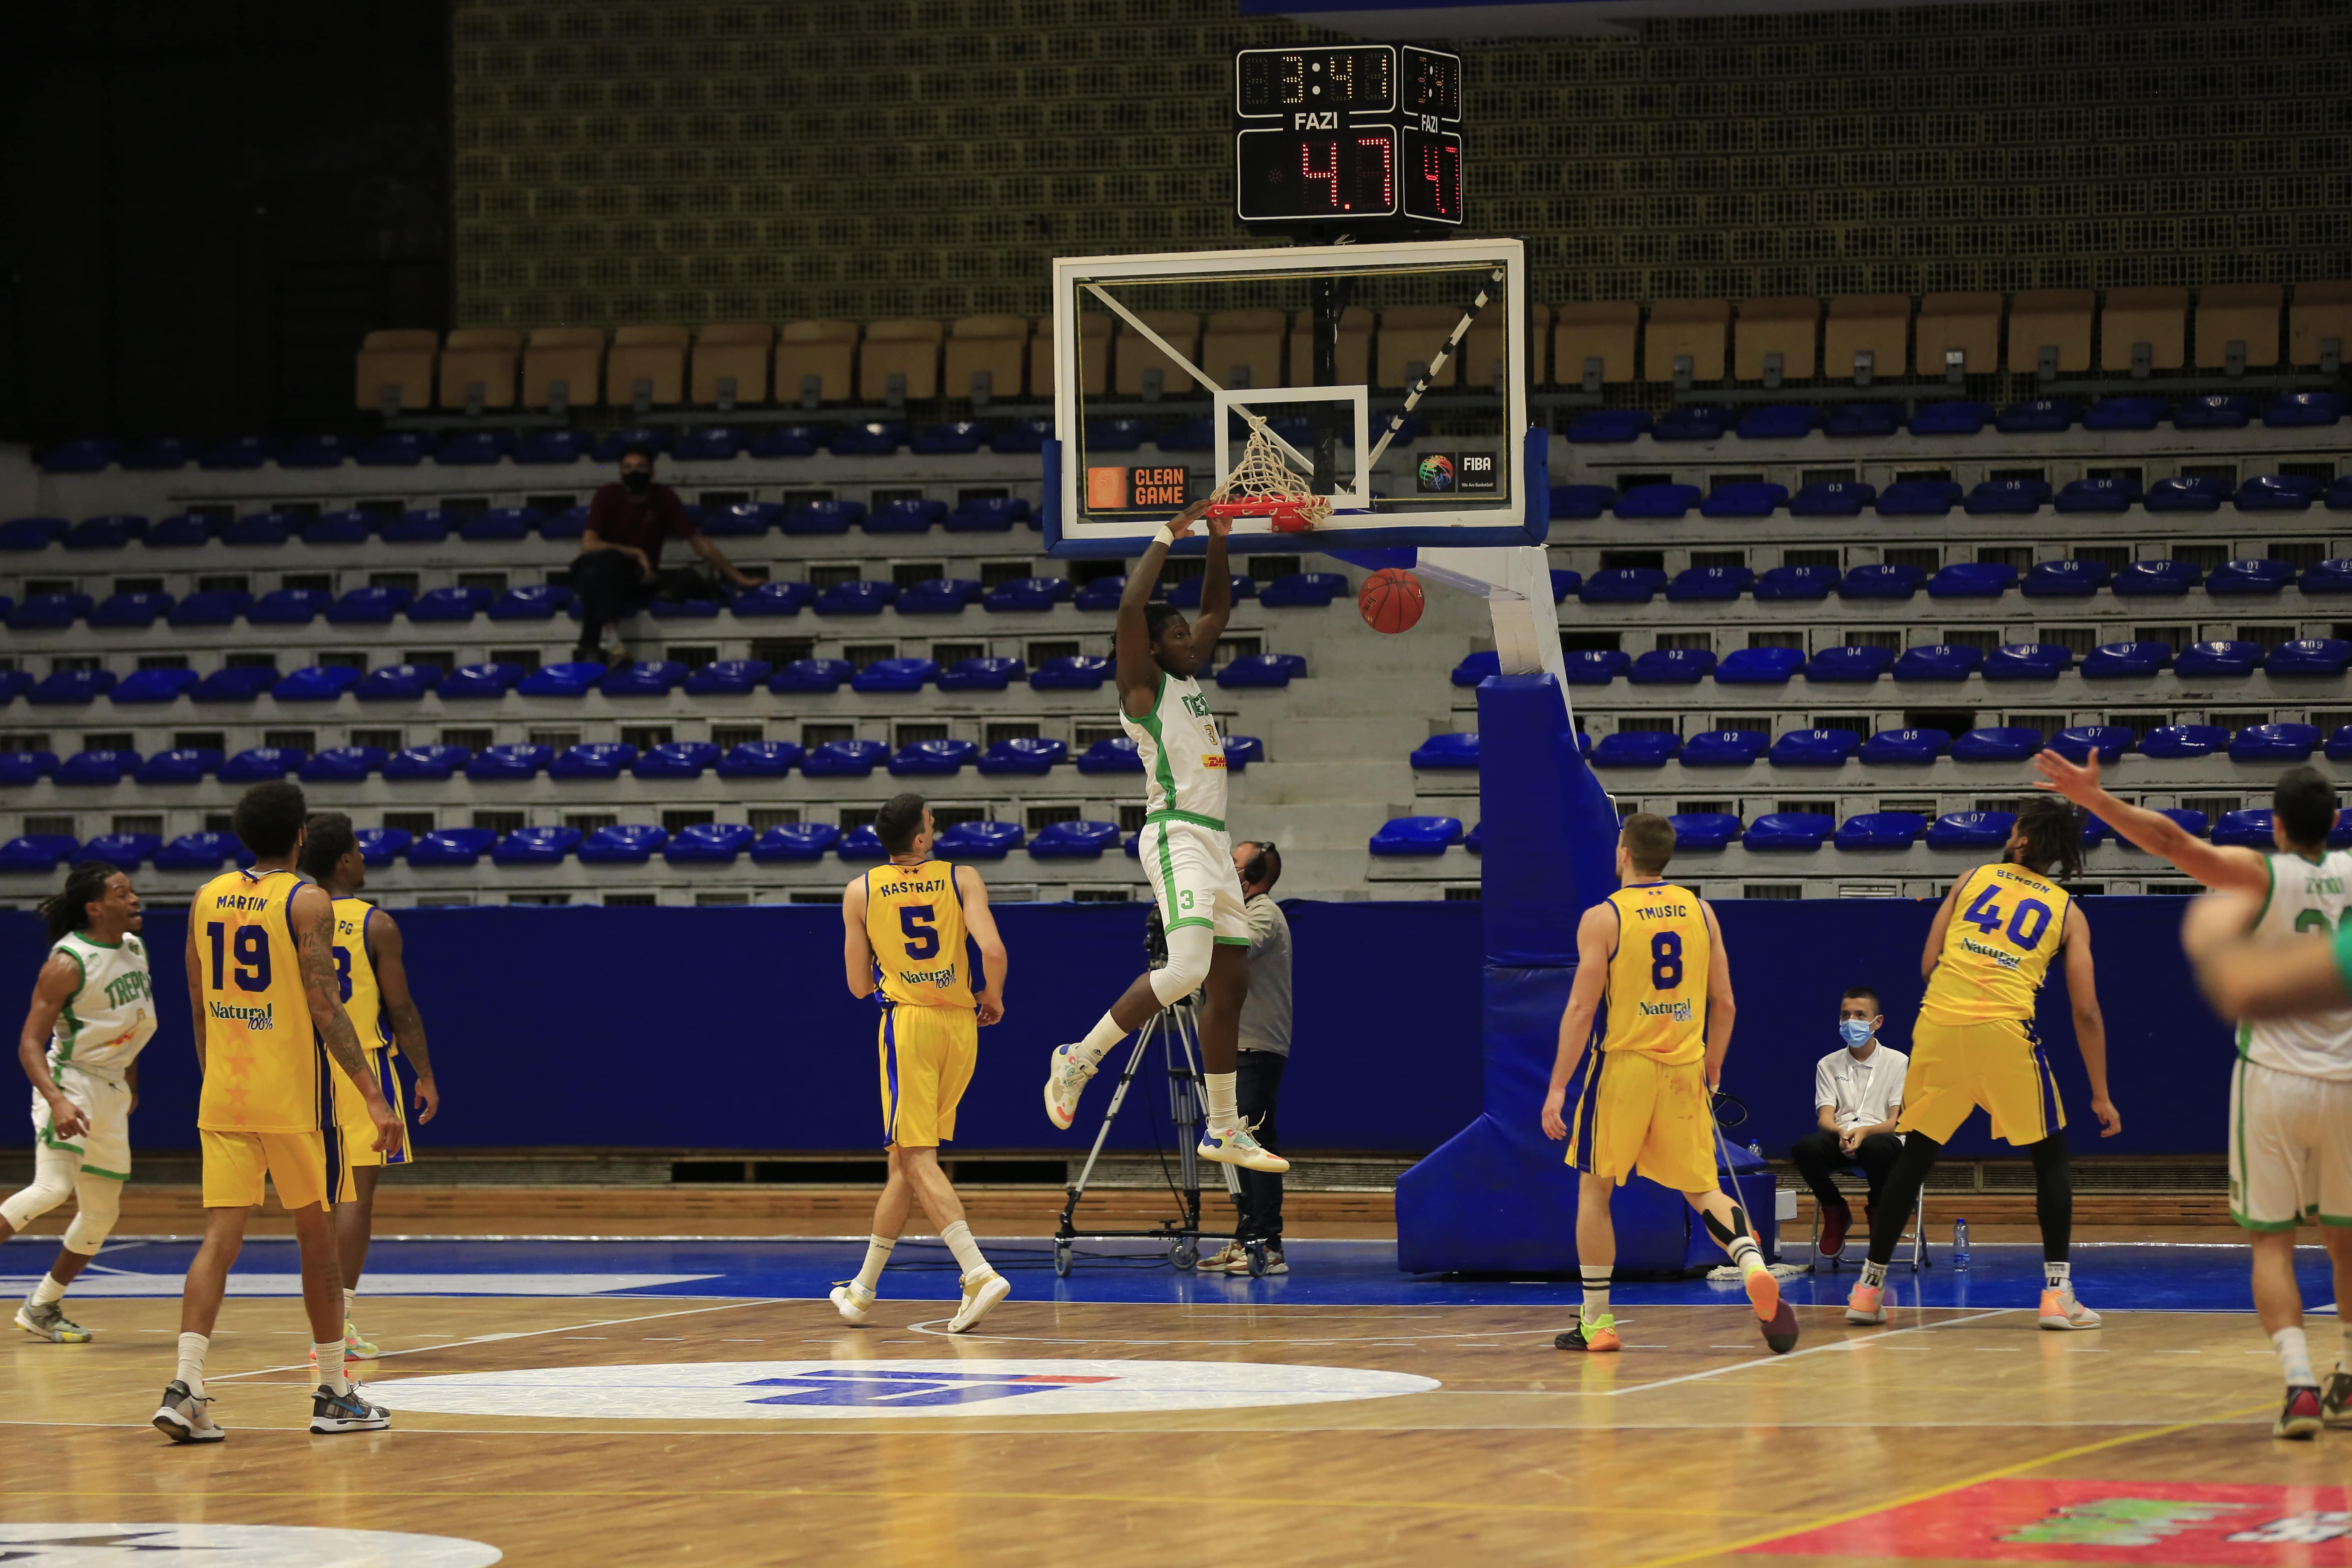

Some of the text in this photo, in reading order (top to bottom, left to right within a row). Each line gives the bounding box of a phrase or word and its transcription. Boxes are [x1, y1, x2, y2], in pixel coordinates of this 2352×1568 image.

[1282, 54, 1387, 103] 3:41
[1295, 112, 1338, 130] FAZI
[1421, 114, 1438, 133] FAZI
[1464, 457, 1490, 470] FIBA
[1135, 469, 1183, 485] CLEAN
[1136, 486, 1183, 505] GAME
[1709, 568, 1723, 577] 02
[1796, 567, 1810, 576] 03
[1882, 565, 1895, 574] 04
[2064, 561, 2078, 570] 06
[2157, 562, 2171, 571] 07
[1621, 570, 1635, 579] 01
[1669, 650, 1684, 659] 02
[1847, 647, 1862, 656] 04
[1936, 646, 1950, 655] 05
[2123, 643, 2138, 653] 07
[1205, 724, 1218, 746] 3
[1724, 732, 1738, 742] 02
[1814, 730, 1828, 739] 04
[1903, 731, 1918, 740] 05
[2088, 727, 2102, 737] 07
[1209, 757, 1227, 767] DH
[1971, 813, 1986, 822] 07
[881, 879, 944, 897] KASTRATI
[1997, 869, 2050, 893] BENSON
[216, 895, 267, 912] MARTIN
[1180, 890, 1194, 909] 3
[1636, 905, 1687, 920] TMUSIC
[1963, 884, 2052, 951] 40
[900, 905, 940, 960] 5
[207, 922, 271, 992] 19
[1960, 938, 2022, 965] Natural
[1651, 931, 1682, 990] 8
[899, 963, 955, 984] Natural
[935, 974, 956, 989] 100%
[209, 1001, 272, 1020] Natural
[1639, 998, 1690, 1016] Natural
[247, 1017, 273, 1030] 100%
